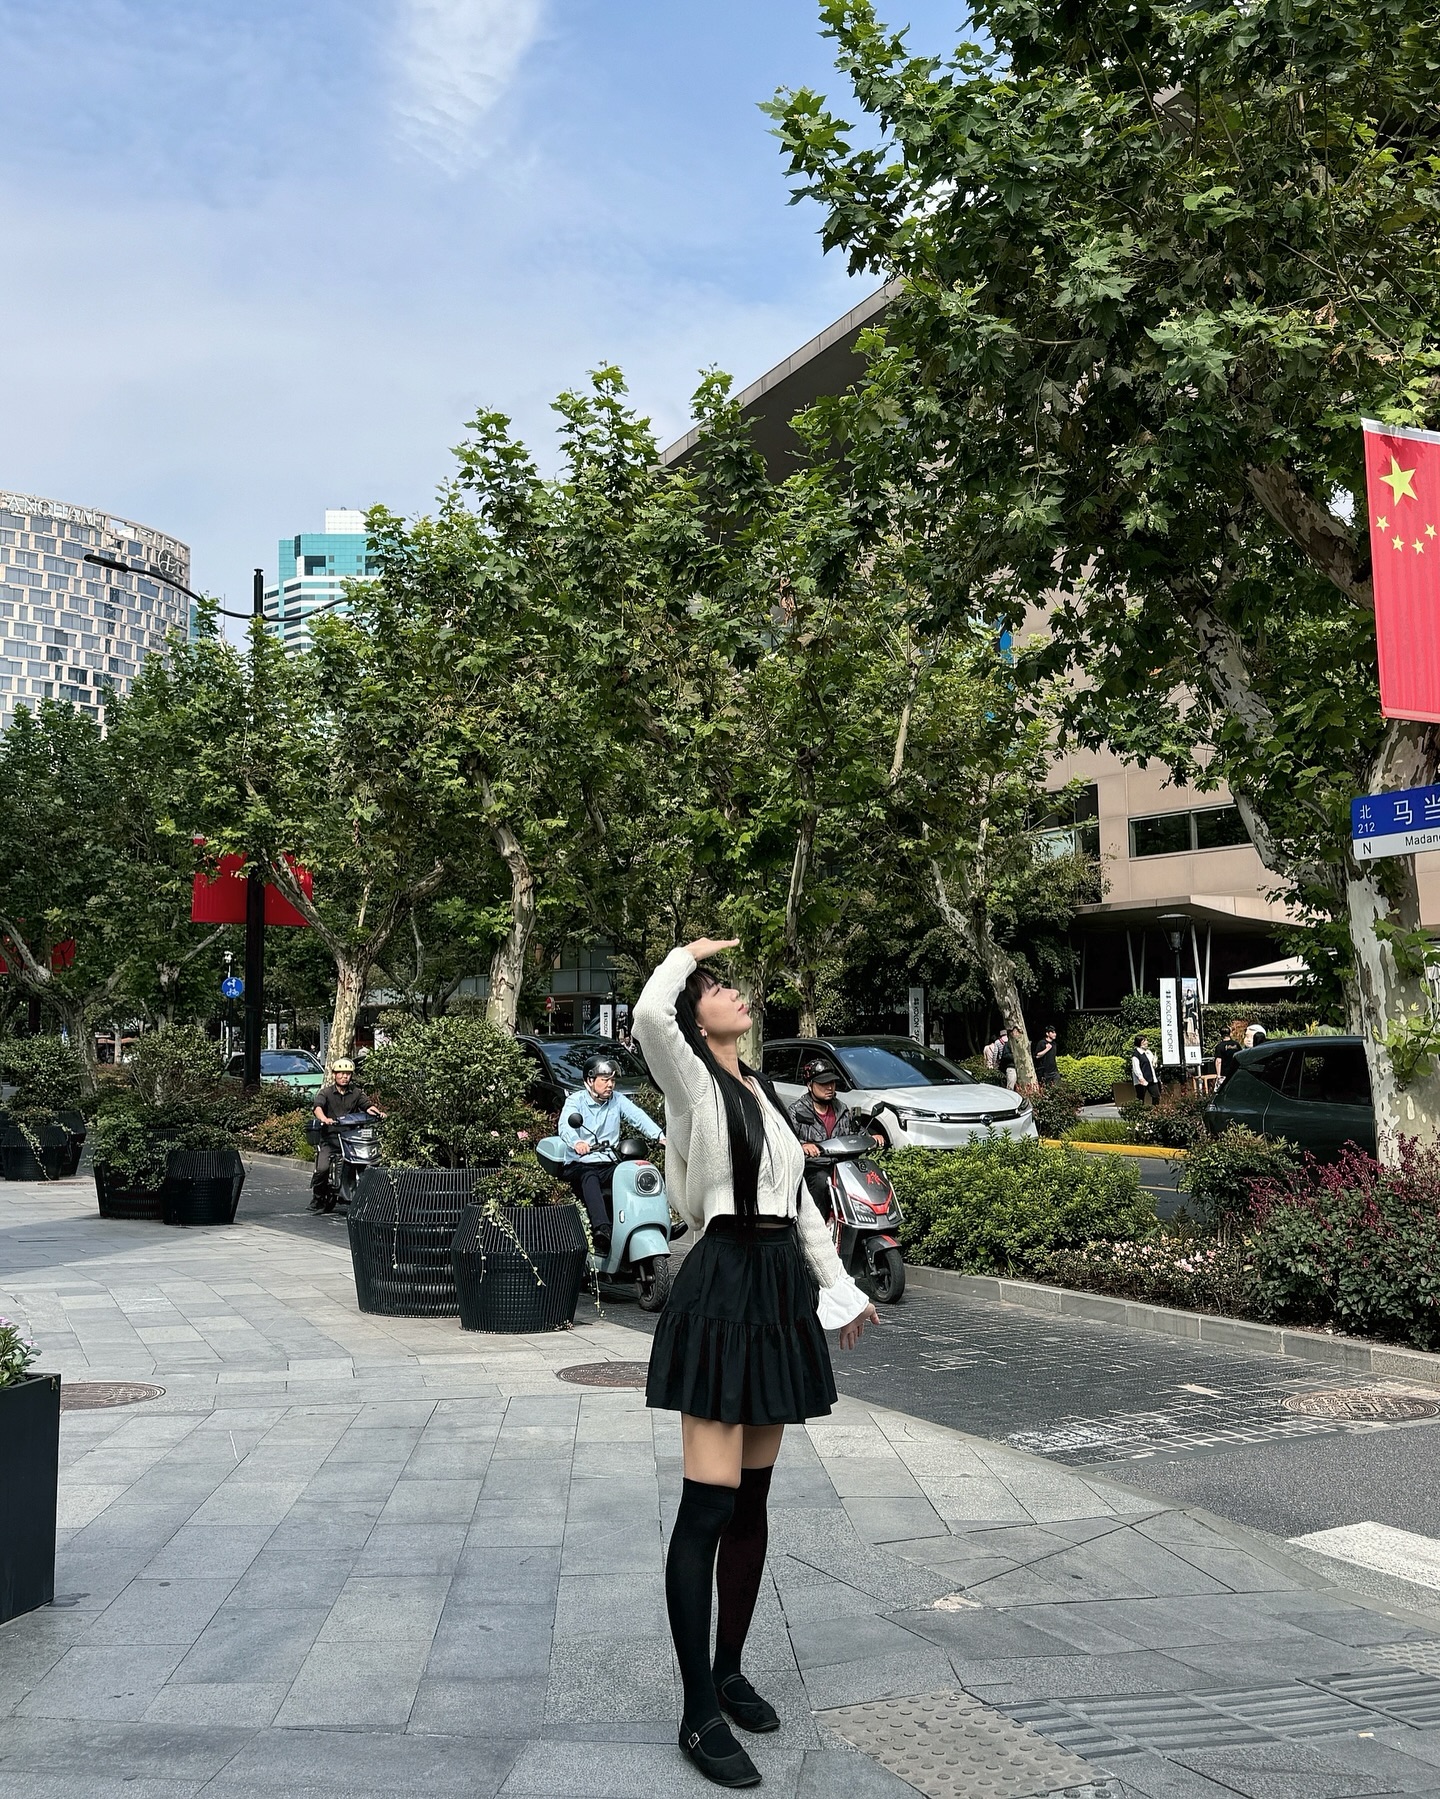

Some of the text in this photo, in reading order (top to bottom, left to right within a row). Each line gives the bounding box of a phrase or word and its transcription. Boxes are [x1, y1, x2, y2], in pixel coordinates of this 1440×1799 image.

[4, 494, 99, 527] ANGHAM
[1360, 804, 1372, 820] 北
[1393, 794, 1440, 826] 马当
[1358, 822, 1375, 834] 212
[1362, 841, 1372, 855] N
[1165, 1000, 1174, 1053] KOLON SPORT
